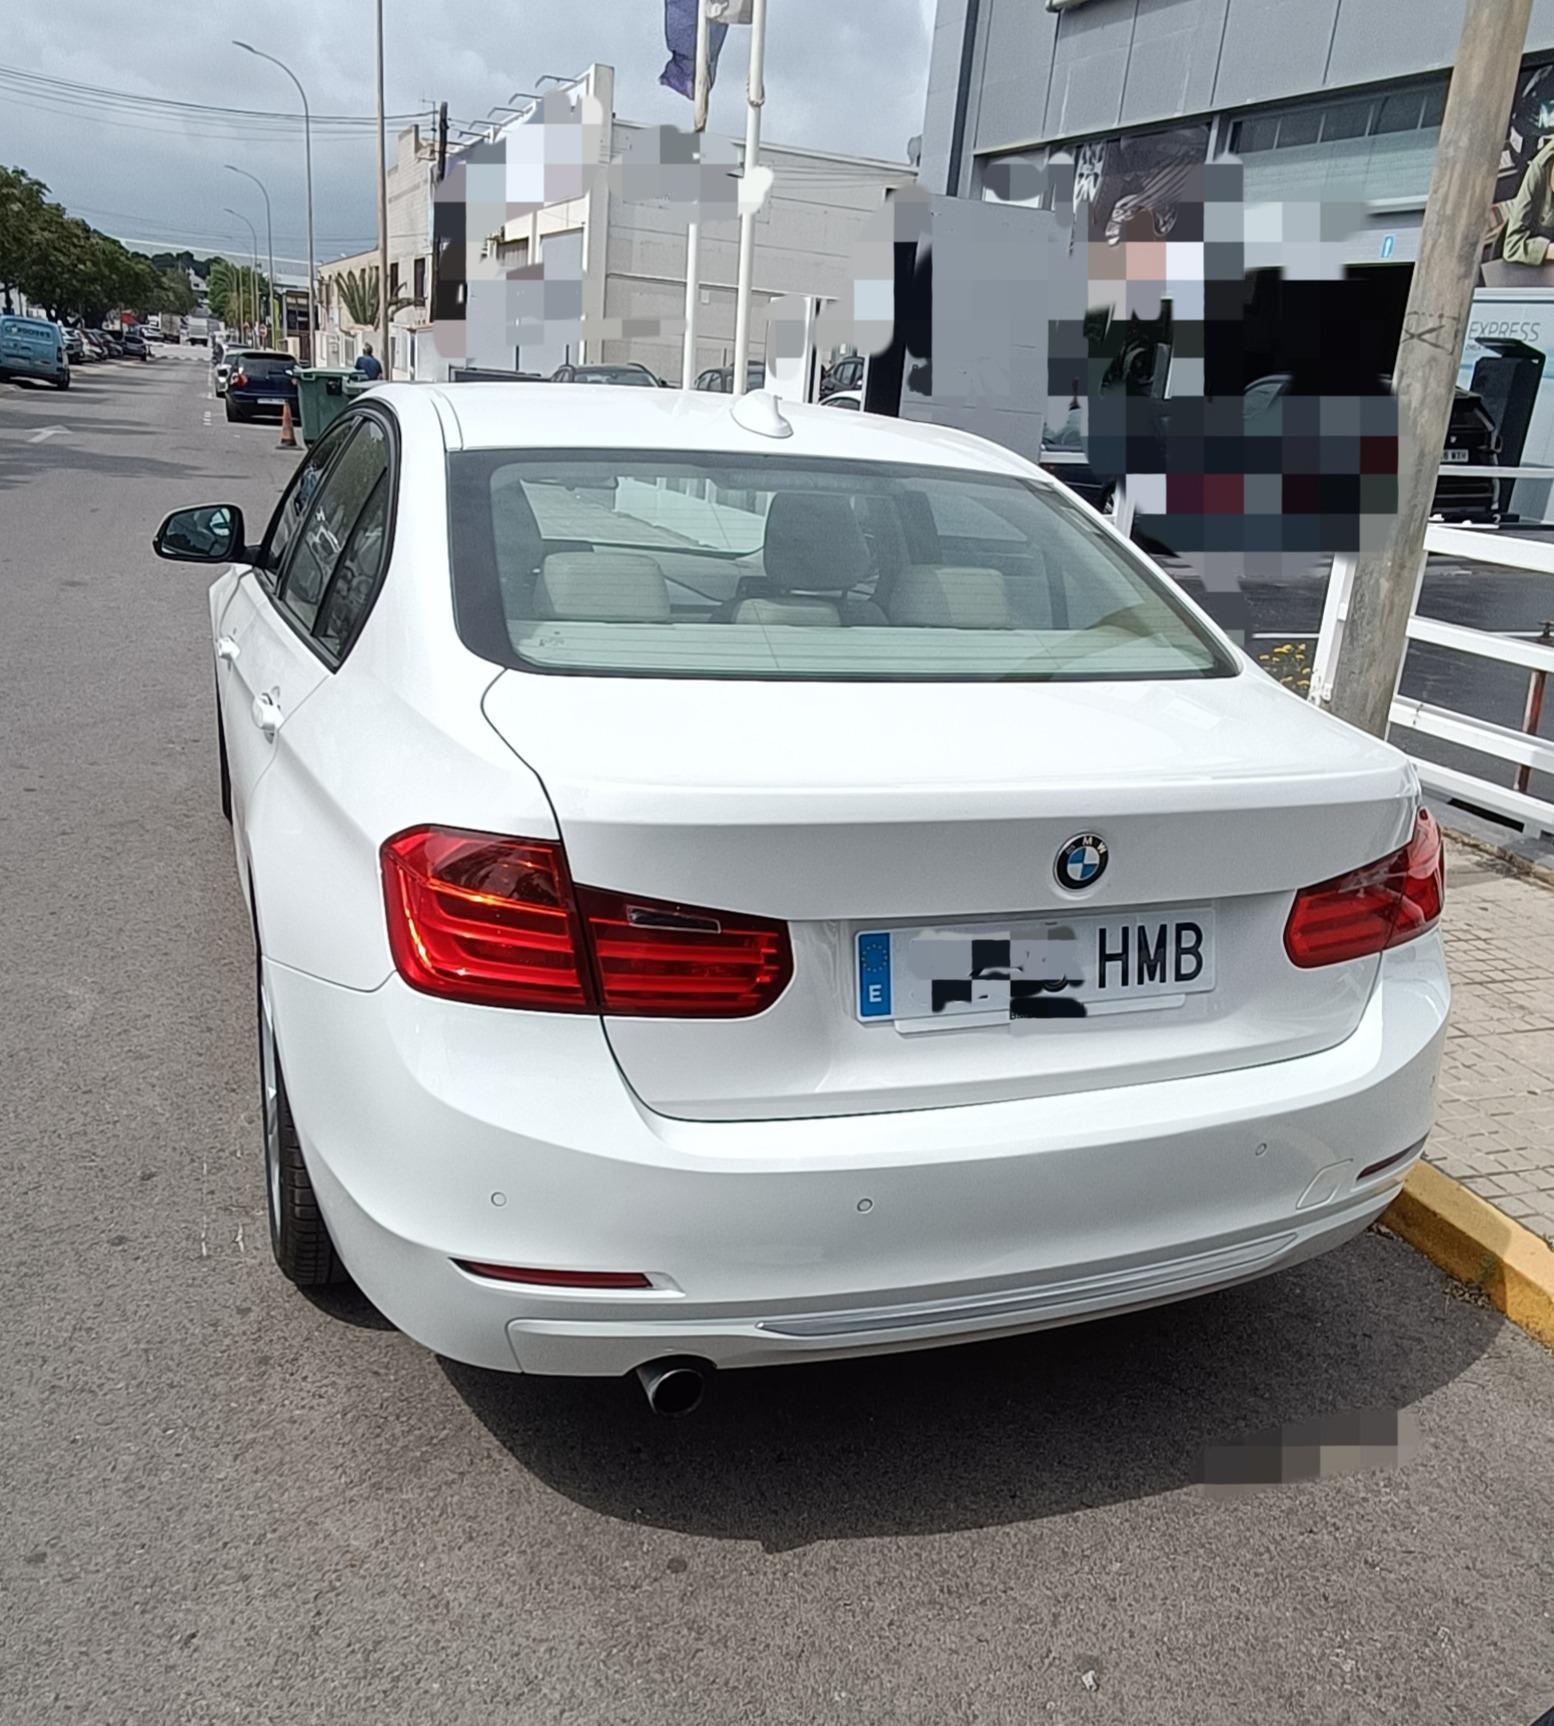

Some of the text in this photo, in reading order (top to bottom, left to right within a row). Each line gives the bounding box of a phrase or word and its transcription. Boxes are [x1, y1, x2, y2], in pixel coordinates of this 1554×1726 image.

[1468, 321, 1541, 342] EXPRESS
[1065, 836, 1107, 855] BMW
[869, 922, 1203, 1002] E HMB
